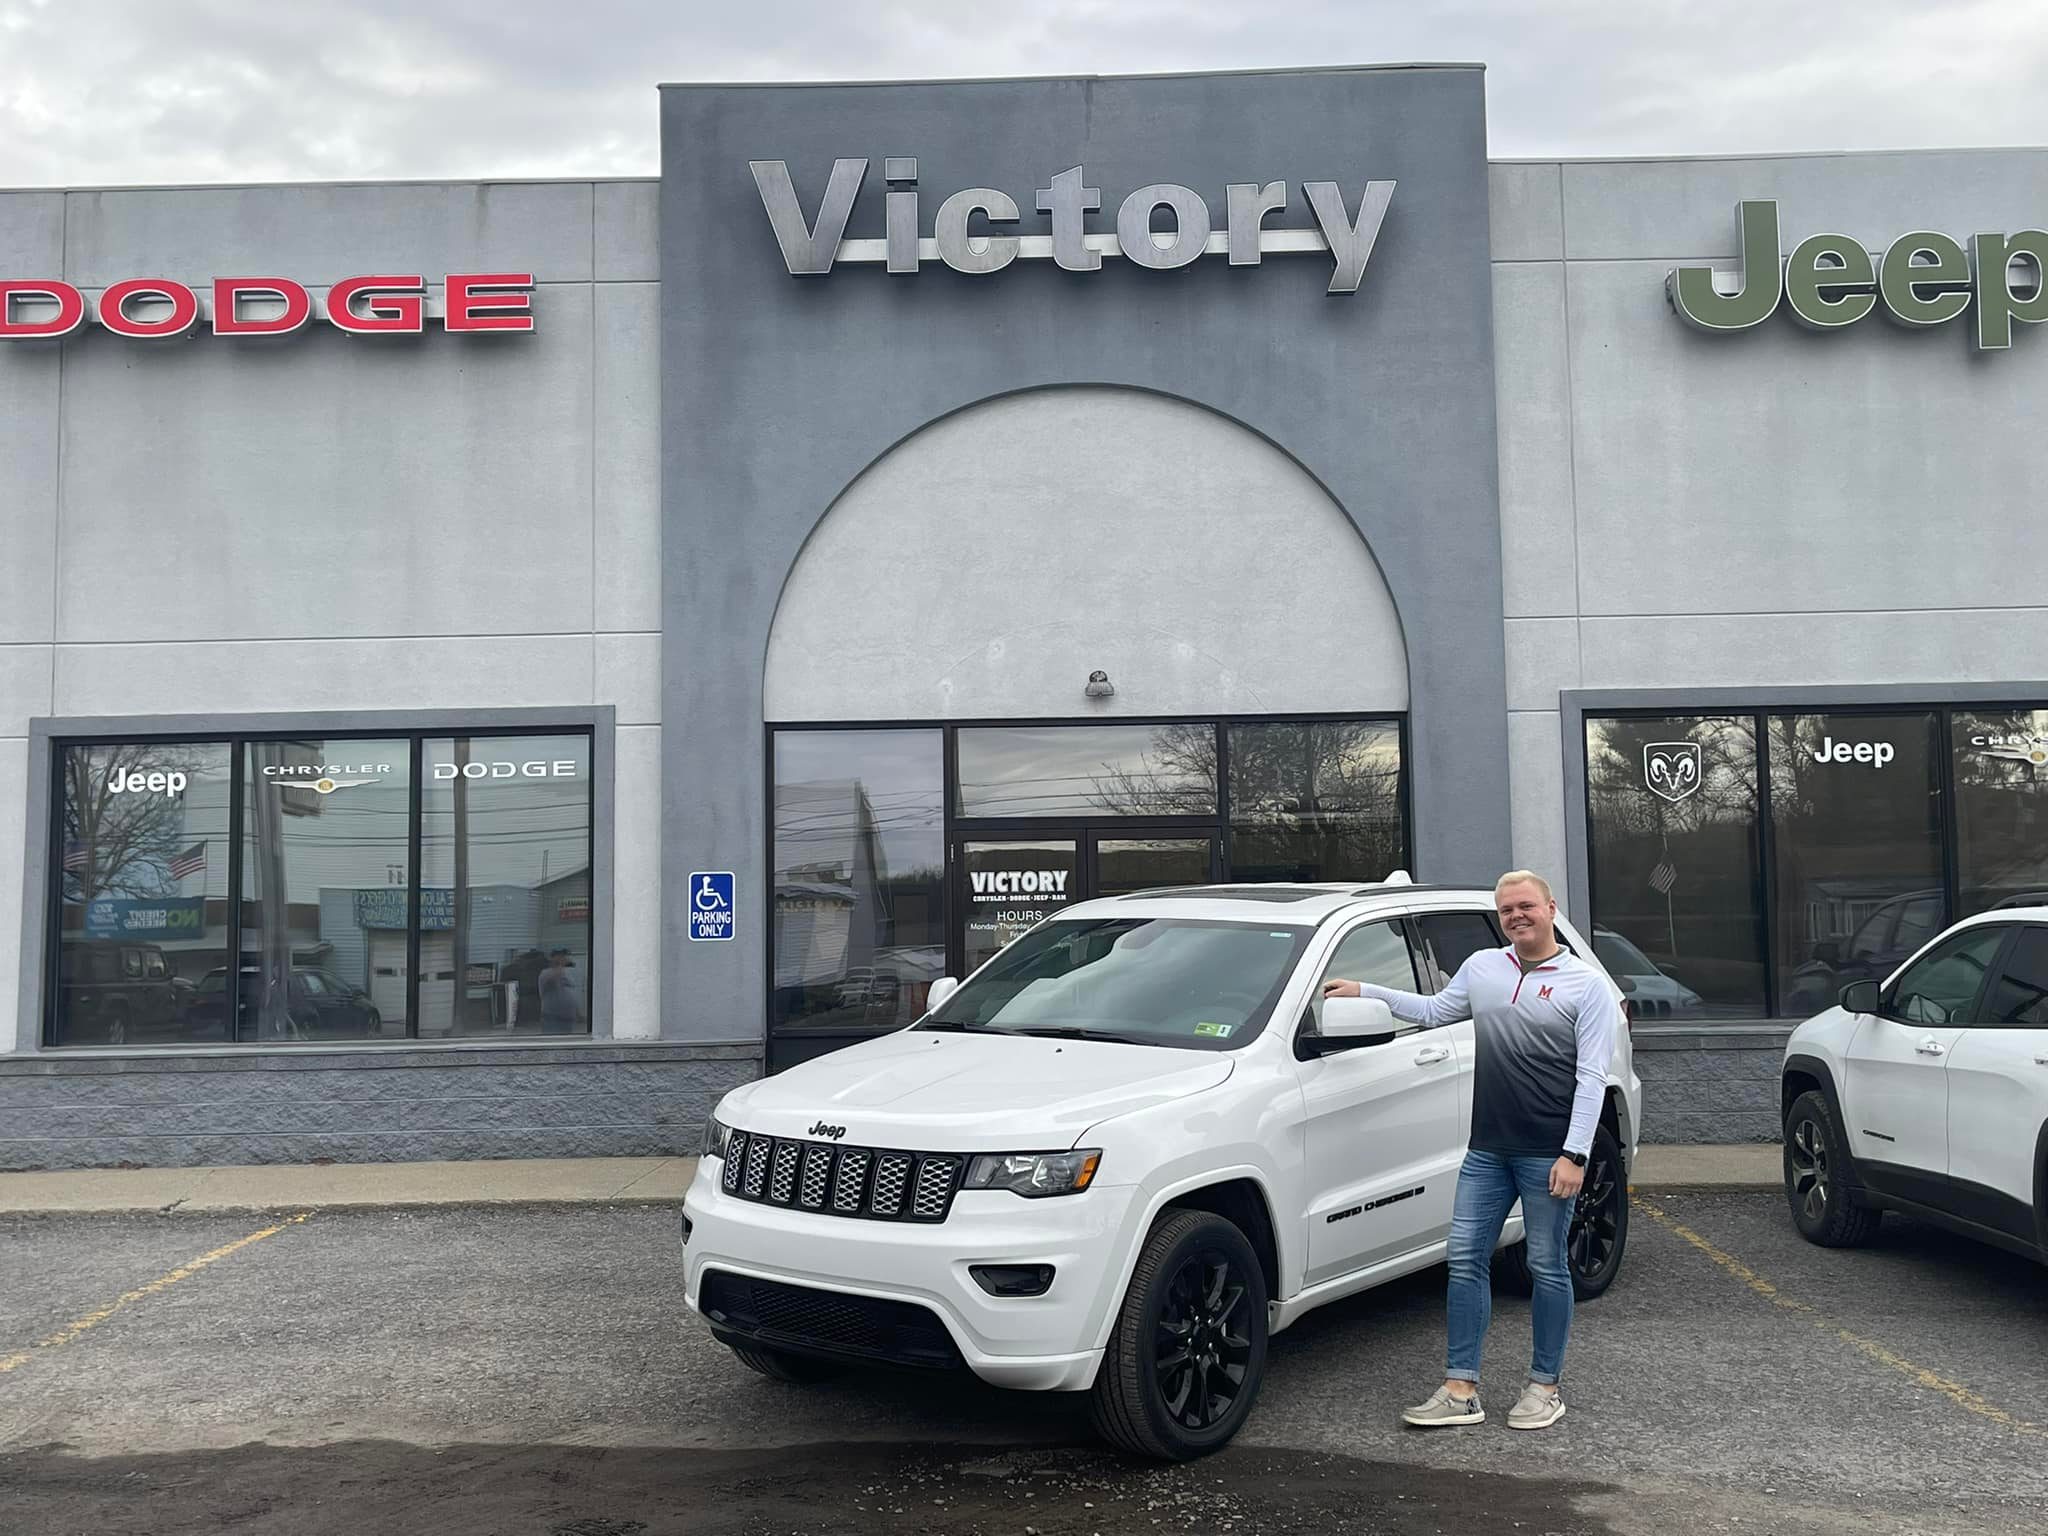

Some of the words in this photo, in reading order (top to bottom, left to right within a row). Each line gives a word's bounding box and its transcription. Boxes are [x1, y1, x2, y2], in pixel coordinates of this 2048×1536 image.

[748, 156, 1398, 294] Victory
[1673, 198, 2048, 350] Jeep
[0, 272, 535, 338] DODGE
[1814, 736, 1895, 768] Jeep
[262, 764, 392, 775] CHRYSLER
[433, 760, 576, 779] DODGE
[107, 767, 187, 798] Jeep
[970, 870, 1068, 893] VICTORY
[692, 911, 731, 924] PARKING
[996, 910, 1043, 921] HOURS
[698, 924, 724, 936] ONLY
[1538, 984, 1554, 998] M
[808, 1119, 847, 1141] Jeep
